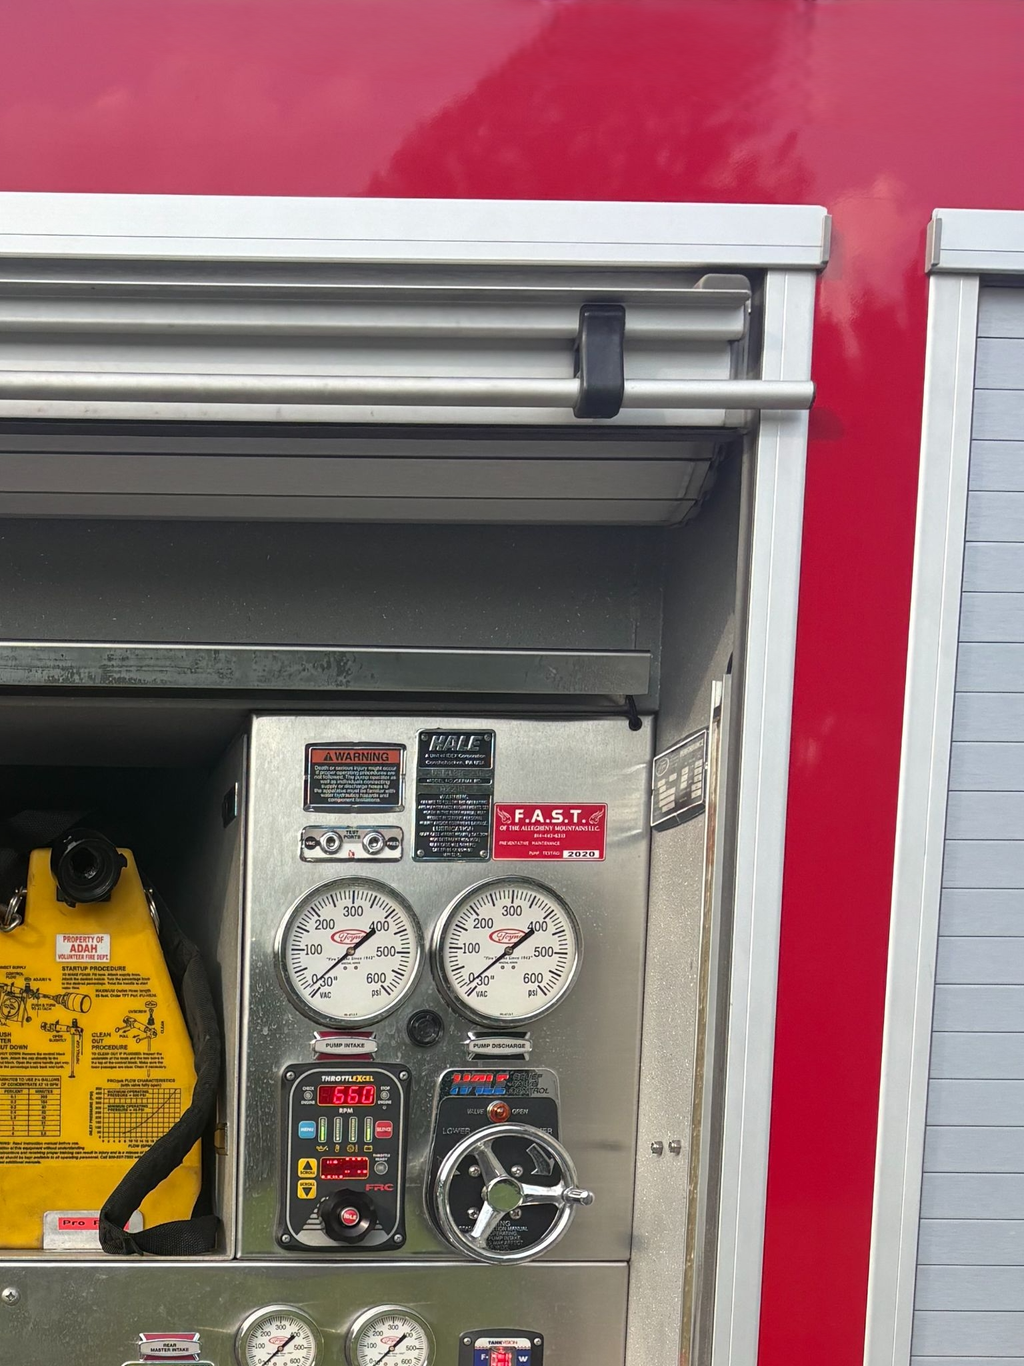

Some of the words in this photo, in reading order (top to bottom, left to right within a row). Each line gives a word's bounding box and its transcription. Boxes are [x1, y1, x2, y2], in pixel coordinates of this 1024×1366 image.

[429, 735, 483, 751] HALE
[334, 752, 389, 761] WARNING
[514, 809, 586, 823] F.A.S.T.
[343, 905, 363, 917] 300
[502, 905, 522, 917] 300
[315, 919, 335, 930] 200
[369, 921, 389, 932] 400
[473, 918, 494, 929] 200
[527, 921, 548, 932] 400
[63, 936, 95, 944] PROPERTY
[70, 944, 98, 953] ADAH
[305, 944, 323, 955] 100
[376, 946, 396, 957] 500
[462, 943, 480, 954] 100
[533, 946, 553, 957] 500
[366, 973, 386, 984] 600
[523, 973, 543, 984] 600
[372, 988, 381, 998] psi
[528, 988, 538, 997] psi
[333, 1086, 375, 1104] 660
[442, 1127, 470, 1135] LOWER
